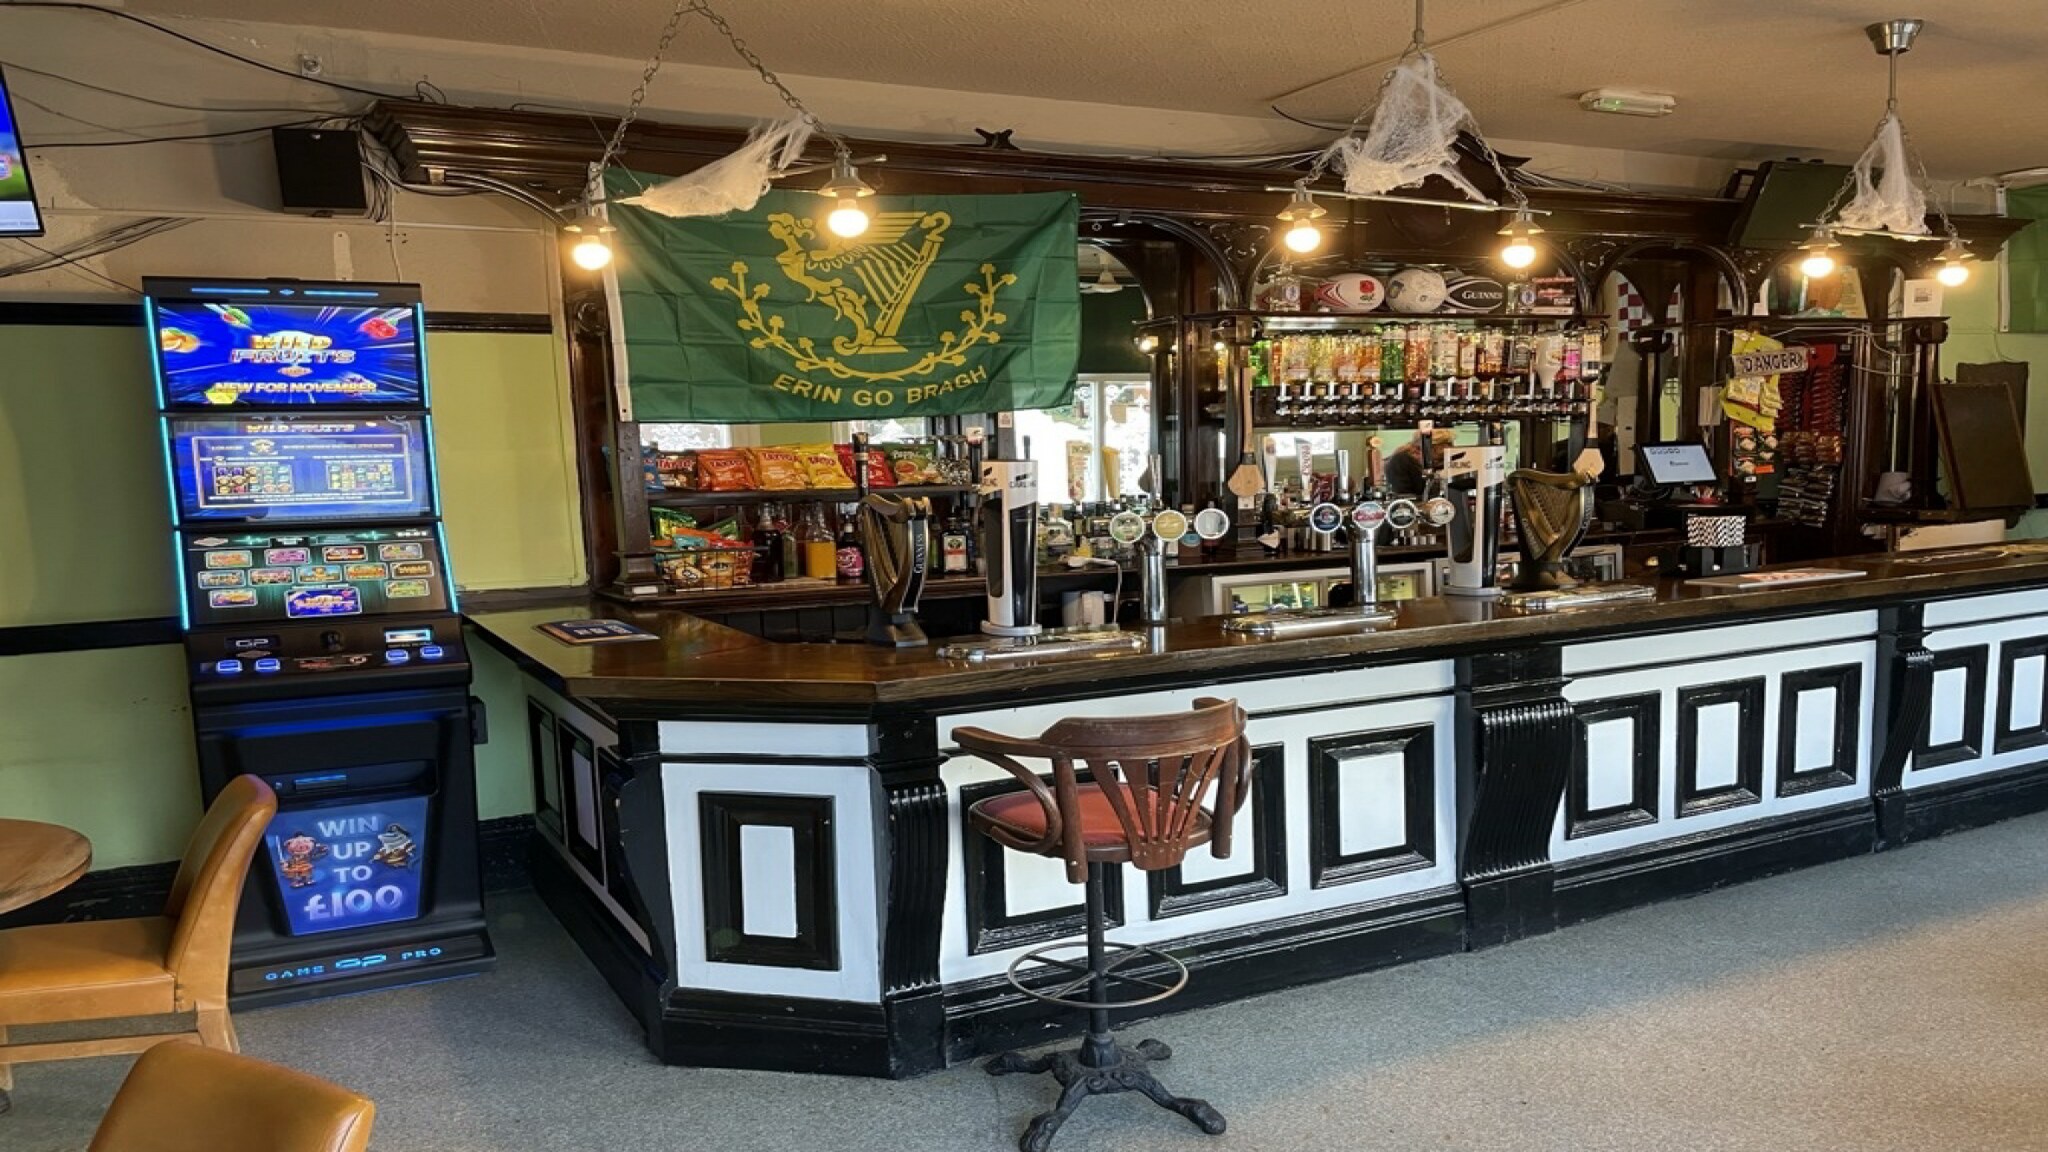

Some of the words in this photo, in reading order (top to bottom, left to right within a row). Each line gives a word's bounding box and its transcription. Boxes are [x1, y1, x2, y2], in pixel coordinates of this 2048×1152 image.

[250, 335, 333, 349] WILD
[231, 348, 356, 364] FRUITS
[214, 382, 254, 394] NEW
[255, 382, 288, 393] FOR
[290, 382, 378, 393] NOVEMBER
[773, 374, 842, 404] ERIN
[853, 389, 894, 406] GO
[907, 365, 988, 404] BRAGH
[235, 638, 269, 648] GP
[317, 816, 379, 838] WIN
[332, 842, 371, 860] UP
[333, 866, 373, 883] TO
[304, 885, 403, 920] £100
[265, 965, 325, 981] GAME
[401, 947, 443, 961] PRO
